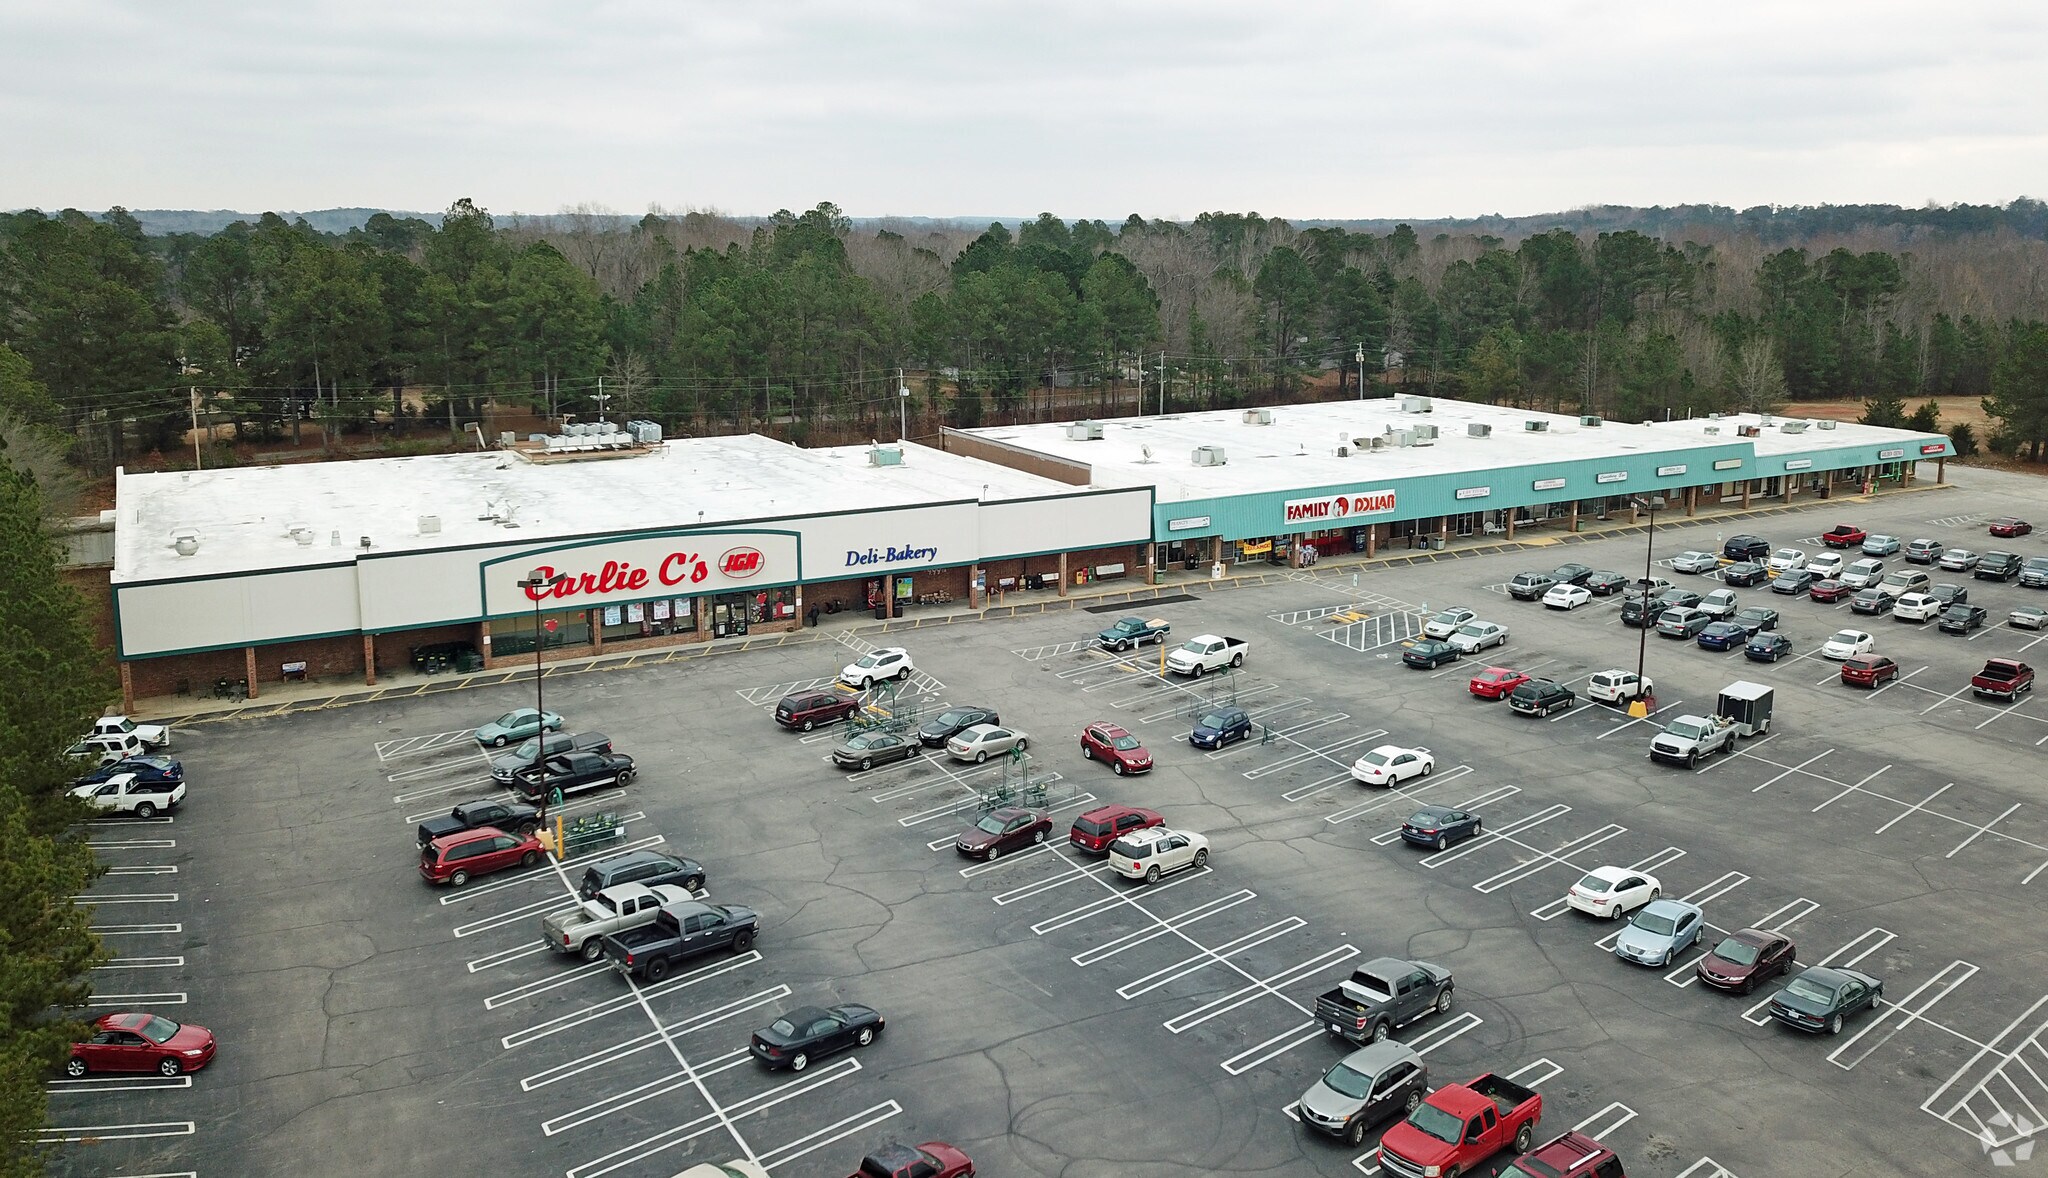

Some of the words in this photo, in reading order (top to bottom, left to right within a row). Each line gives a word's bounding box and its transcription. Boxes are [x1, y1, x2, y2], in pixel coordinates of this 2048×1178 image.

[1287, 501, 1331, 520] FAMILY
[1354, 494, 1395, 513] DOLLAR
[724, 552, 760, 572] IGA
[844, 544, 938, 567] Deli-Bakery
[524, 560, 650, 601] Carlie
[658, 552, 709, 586] C's
